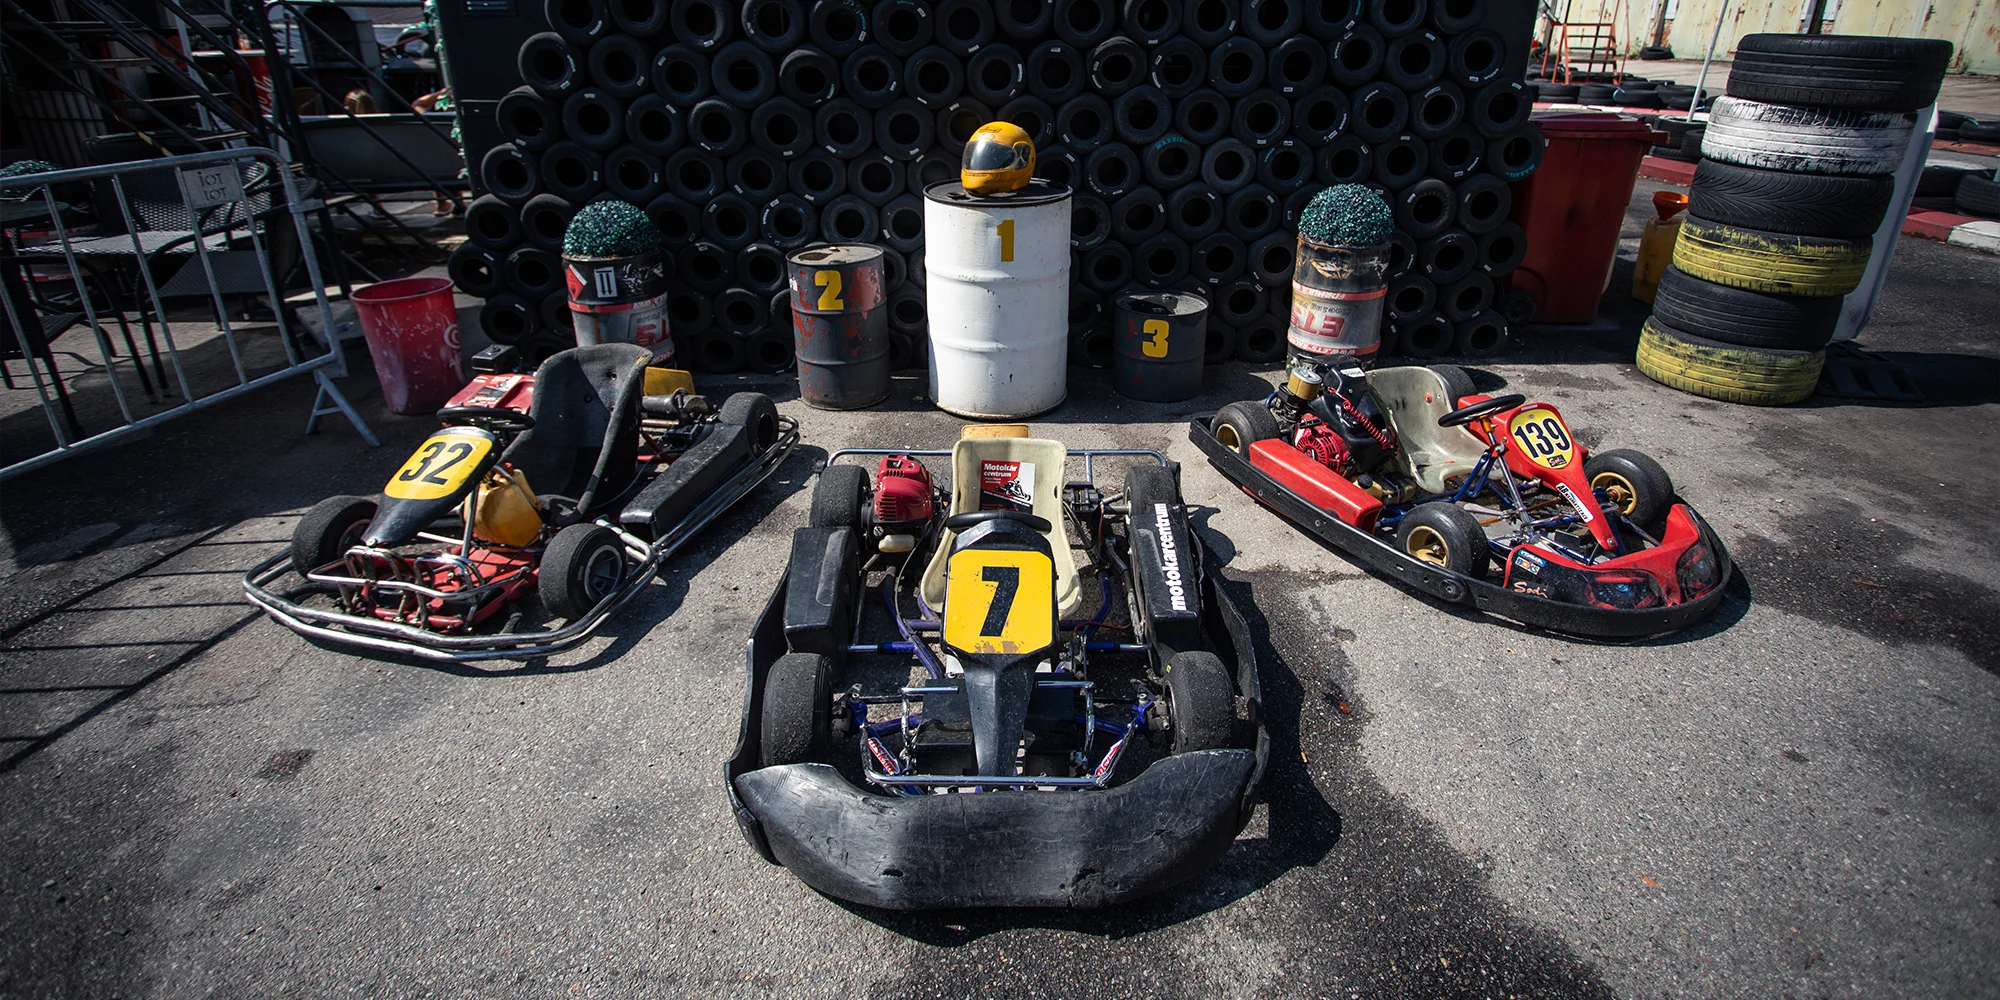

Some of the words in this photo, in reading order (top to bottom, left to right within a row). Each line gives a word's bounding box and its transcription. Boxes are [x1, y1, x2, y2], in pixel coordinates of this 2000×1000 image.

[1155, 136, 1184, 150] MAXXIS
[996, 219, 1015, 262] 1
[814, 269, 844, 311] 2
[1141, 318, 1170, 359] 3
[1513, 417, 1571, 459] 139
[399, 441, 474, 485] 32
[1154, 503, 1187, 611] motokarcentrum
[979, 566, 1020, 637] 7
[1513, 581, 1549, 599] Sodi
